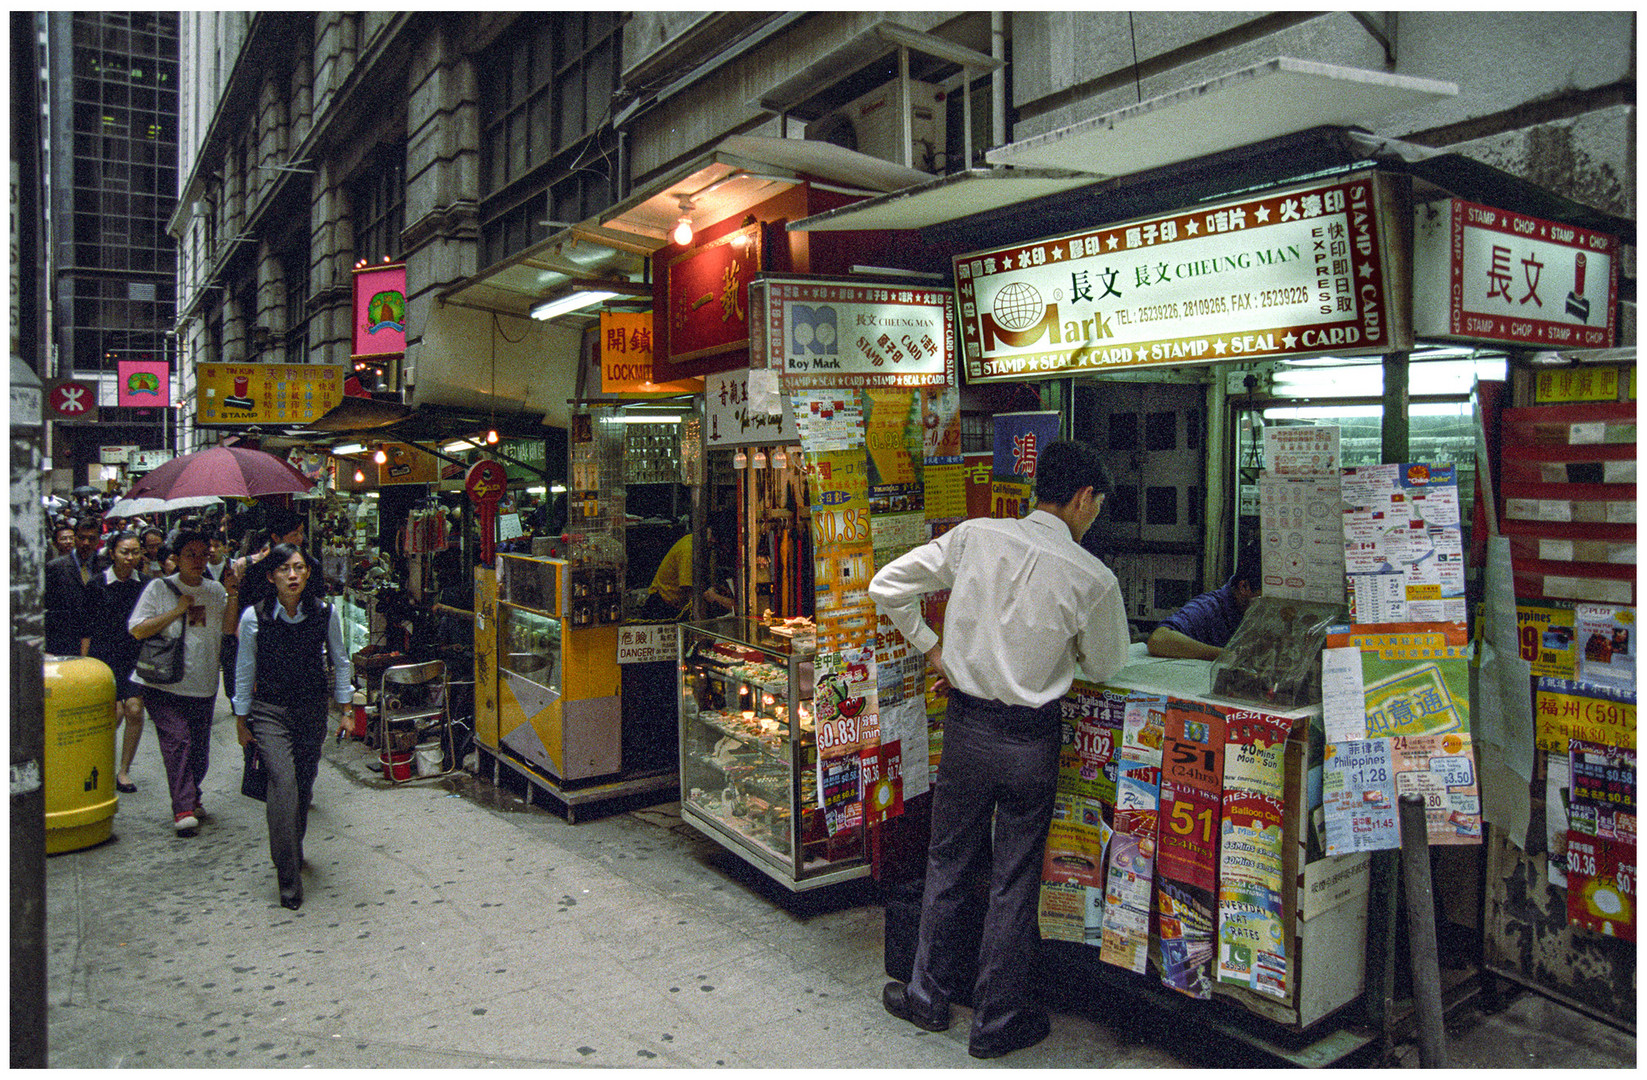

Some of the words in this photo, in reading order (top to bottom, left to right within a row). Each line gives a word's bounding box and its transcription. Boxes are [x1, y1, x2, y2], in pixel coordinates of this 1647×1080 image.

[1453, 202, 1462, 260] STAMP
[1469, 208, 1496, 225] STAMP
[1514, 218, 1535, 234] CHOP
[1551, 227, 1574, 243] STAMP
[1590, 235, 1608, 249] CHOP
[1176, 253, 1251, 279] CHEUNG
[1256, 244, 1301, 268] MAN
[1312, 228, 1333, 315] EXPRESS
[1328, 222, 1352, 313] 快印即日取
[1351, 186, 1371, 256] STAMP
[1361, 284, 1380, 341] CARD
[1070, 267, 1122, 304] 長文
[1135, 261, 1171, 288] 長文
[1486, 245, 1545, 308] 長文
[945, 295, 954, 322] STAMP
[1260, 286, 1309, 309] 25239226
[1453, 284, 1462, 333] CHOP
[878, 318, 913, 327] CHEUNG
[915, 319, 934, 327] MAN
[1467, 319, 1494, 332] STAMP
[1511, 324, 1533, 336] CHOP
[1548, 327, 1571, 340] STAMP
[1585, 331, 1604, 343] CHOP
[608, 327, 652, 354] 開鎖
[856, 336, 884, 367] STAMP
[901, 334, 922, 361] CARD
[945, 329, 954, 351] CARD
[983, 358, 1027, 375] STAMP
[1040, 352, 1076, 369] SEAL
[1090, 347, 1132, 366] CARD
[1152, 339, 1209, 360] STAMP
[1231, 334, 1279, 353] SEAL
[1301, 326, 1360, 348] CARD
[789, 358, 809, 371] Roy
[813, 358, 841, 369] Mark
[845, 375, 864, 386] CARD
[873, 375, 896, 386] STAMP
[903, 375, 920, 385] SEAL
[927, 375, 945, 385] CARD
[815, 508, 869, 544] $0.85
[621, 647, 654, 658] DANGER!
[1077, 693, 1109, 708] Thailand
[1226, 711, 1261, 724] FIESTA
[1265, 715, 1292, 734] CALL
[1365, 687, 1444, 738] 如意通
[862, 728, 881, 740] min
[1077, 720, 1111, 737] Philippines
[1074, 731, 1111, 757] $1.02
[1348, 741, 1385, 755] 菲律賓
[1394, 737, 1408, 750] 24
[1171, 742, 1215, 772] 51
[1236, 754, 1255, 764] Mon
[1262, 759, 1278, 769] Sun
[1334, 755, 1386, 769] Philippines
[1171, 764, 1220, 786] (24hrs)
[1352, 768, 1387, 783] $1.28
[1444, 772, 1470, 784] $3.50
[1606, 770, 1633, 785] $0.58
[1223, 791, 1262, 806] FIESTA
[1169, 800, 1213, 843] 51
[1231, 805, 1263, 818] Balloon
[1265, 811, 1281, 823] Card
[1238, 827, 1257, 837] Map
[1163, 836, 1213, 859] (24hrs)
[1567, 850, 1596, 876] $0.36
[1220, 900, 1266, 915] EVERYDAY
[1224, 912, 1248, 925] FLAT
[1230, 926, 1260, 941] RATES
